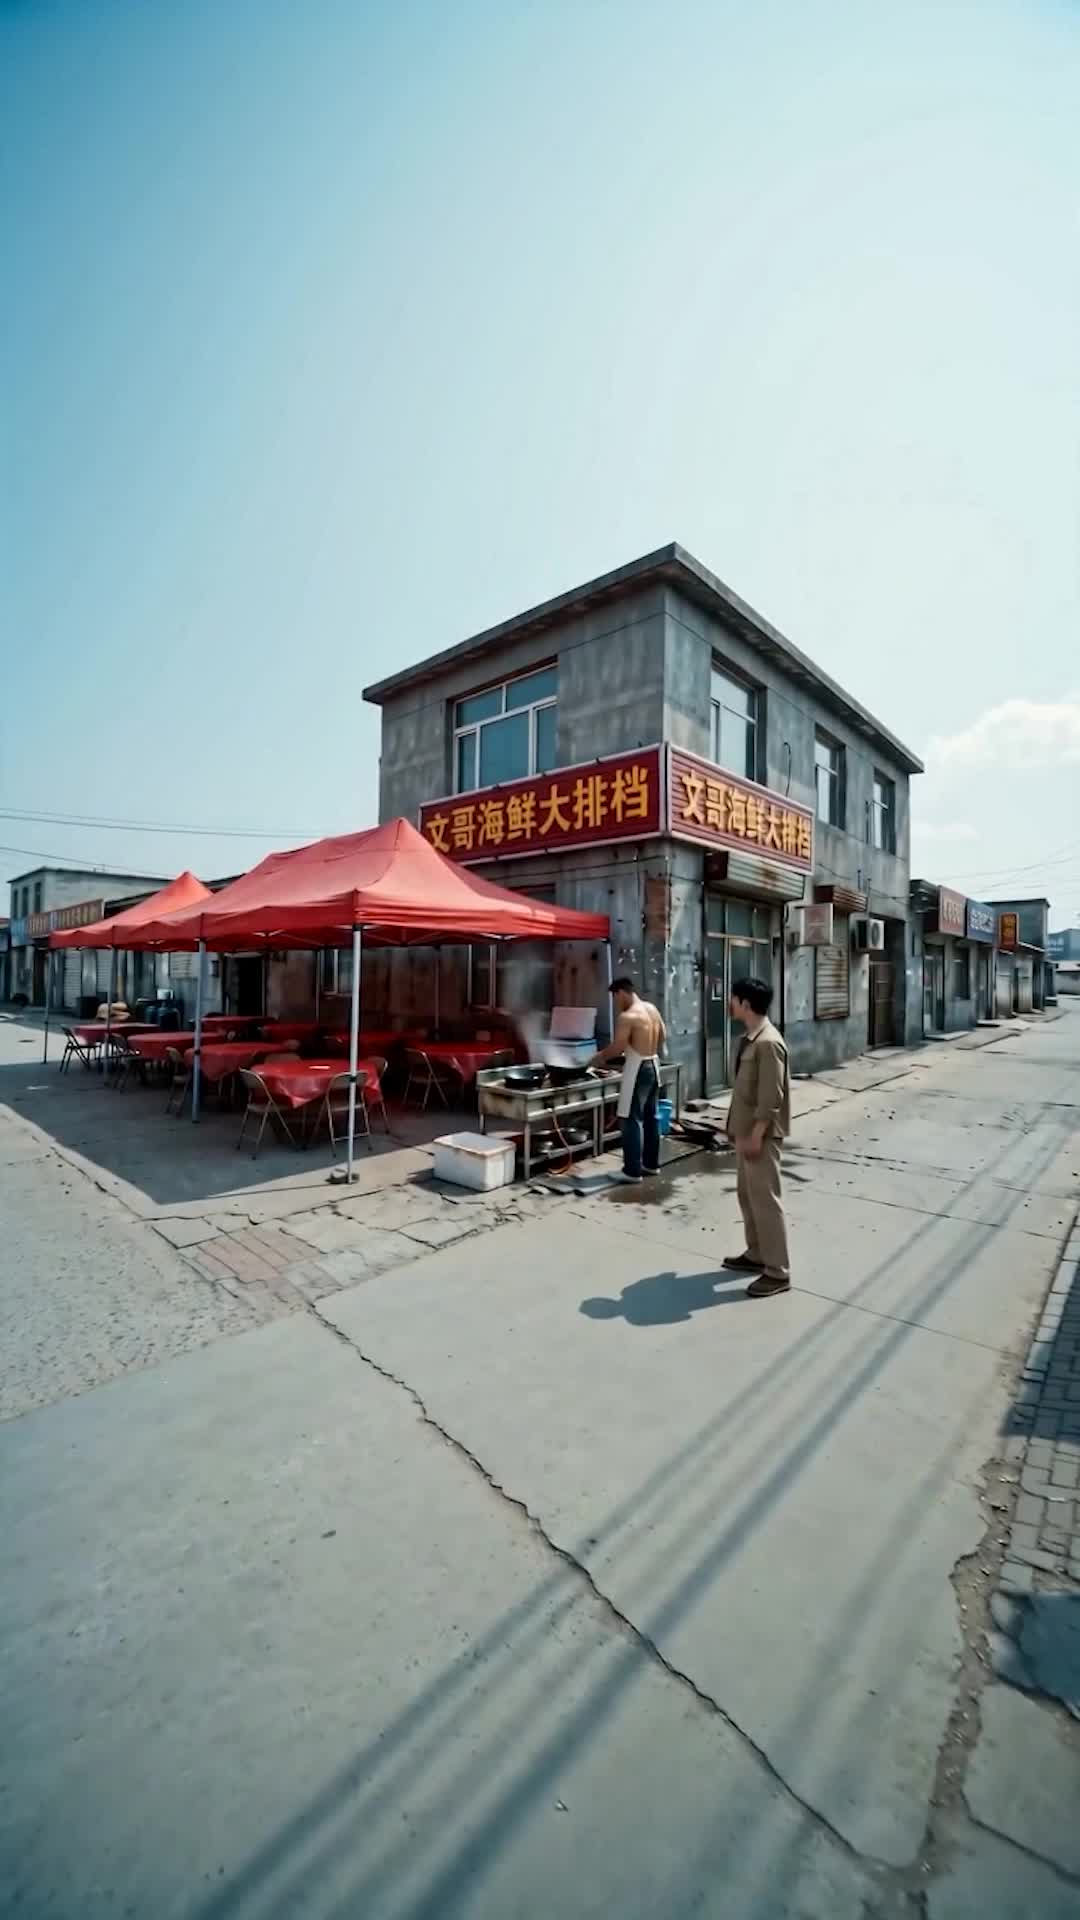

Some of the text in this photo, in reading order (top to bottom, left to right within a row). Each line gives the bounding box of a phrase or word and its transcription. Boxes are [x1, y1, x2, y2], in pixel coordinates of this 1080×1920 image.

[426, 765, 649, 854] 文哥海鲜大排档
[681, 769, 812, 859] 文哥海鲜大排档
